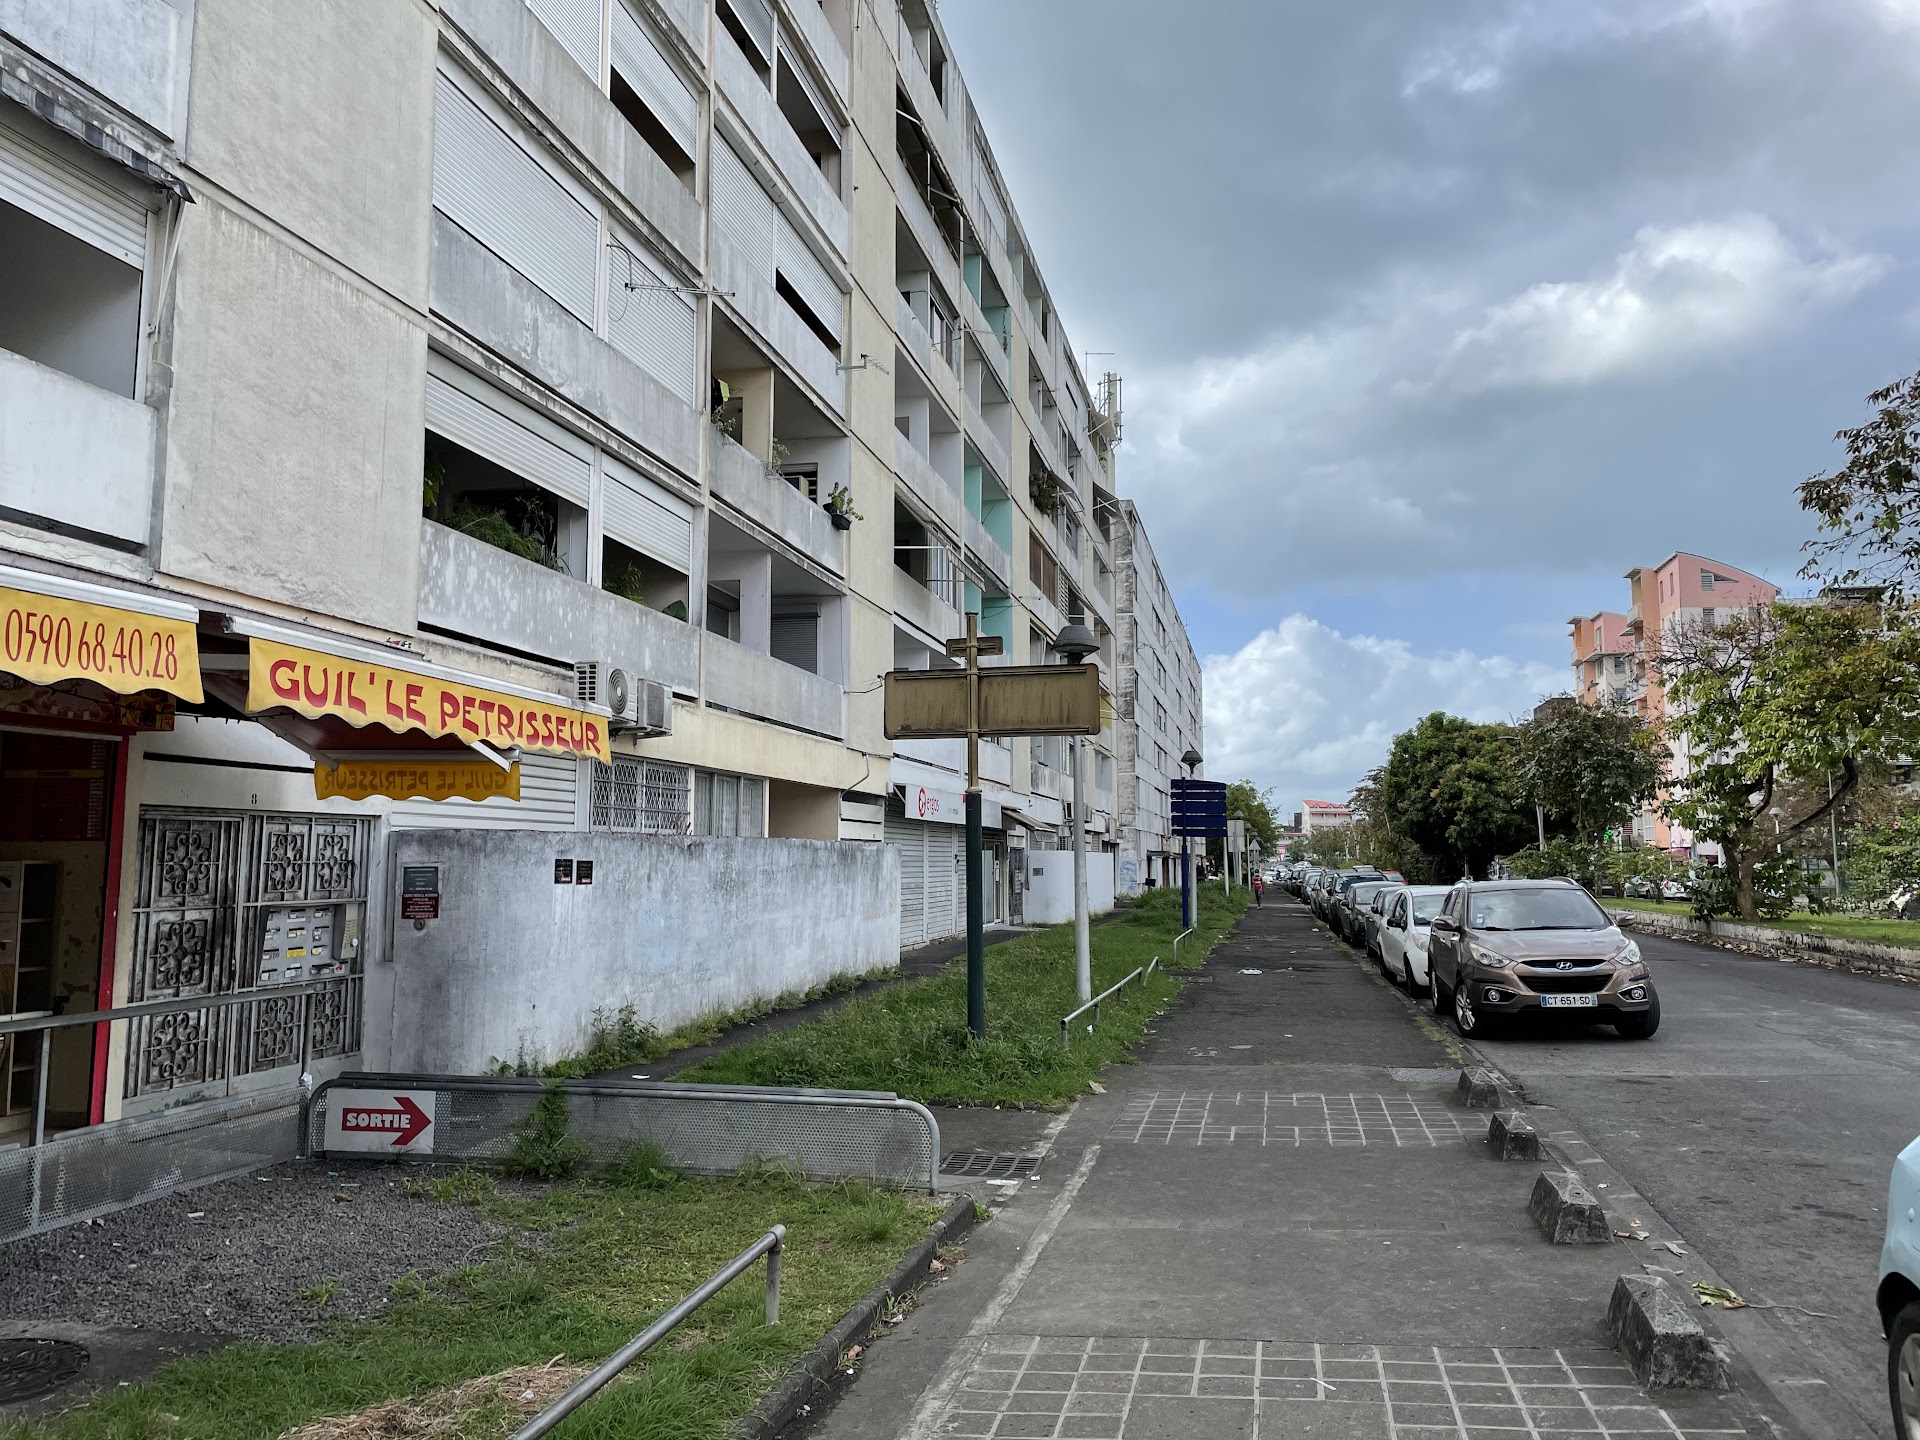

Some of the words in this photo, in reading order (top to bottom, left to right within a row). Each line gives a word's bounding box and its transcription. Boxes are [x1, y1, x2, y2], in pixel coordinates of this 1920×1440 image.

[5, 609, 72, 668] 0590
[78, 621, 178, 680] 68.40.28
[440, 691, 601, 754] PETRISSEUR
[346, 1112, 411, 1129] SORTIE
